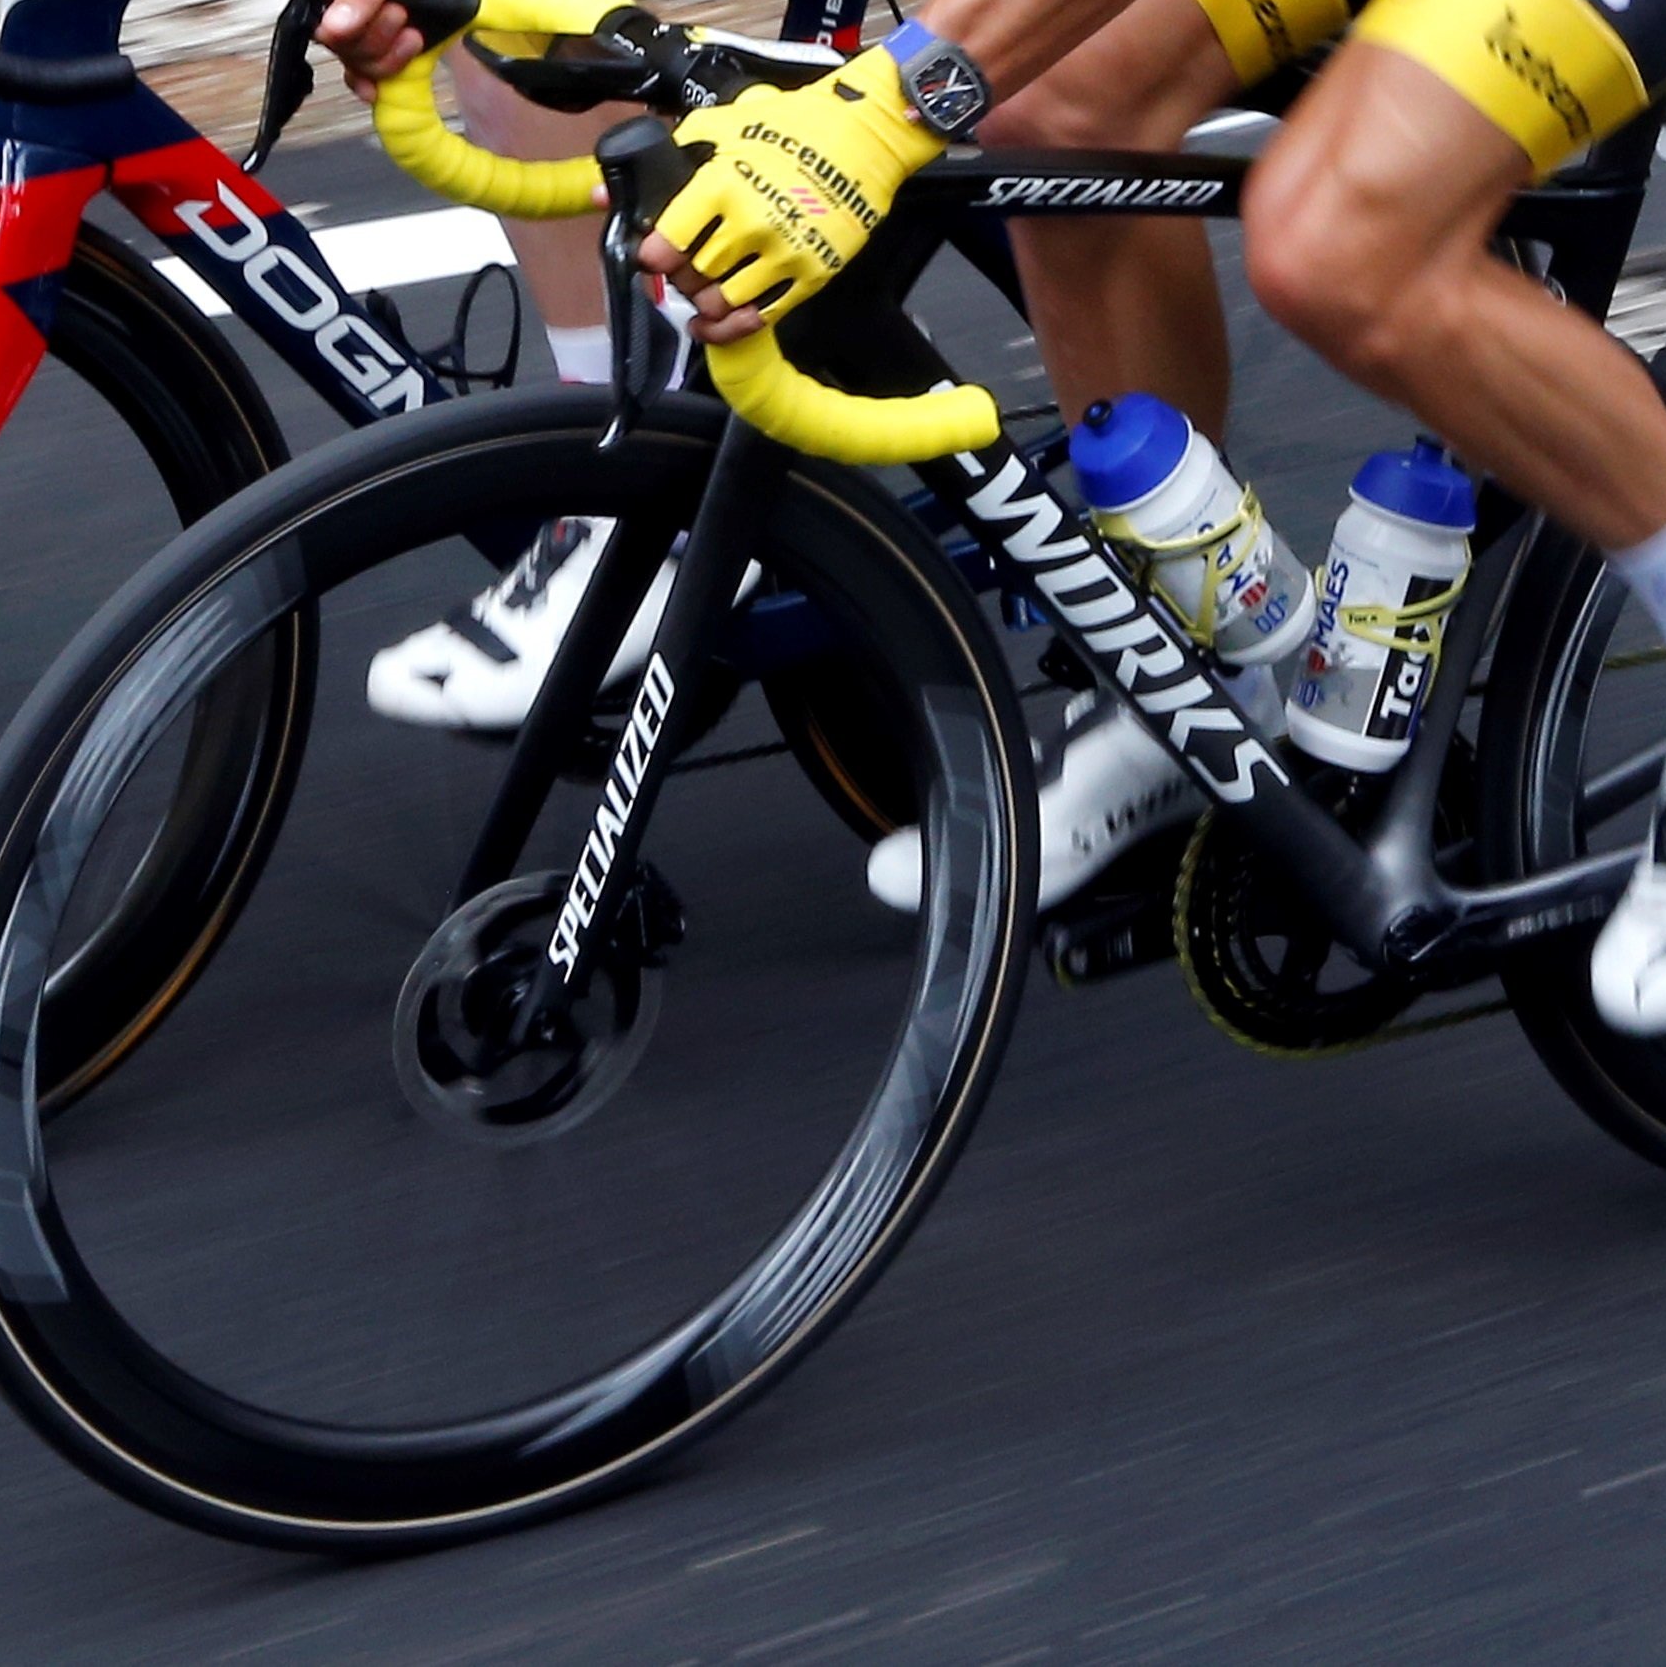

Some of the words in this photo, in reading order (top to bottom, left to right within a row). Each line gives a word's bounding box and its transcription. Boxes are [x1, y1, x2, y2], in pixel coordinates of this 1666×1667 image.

[740, 122, 880, 230] deceuninc
[970, 177, 1224, 208] SPECIALIZED
[930, 378, 1290, 804] -WORKS
[1313, 558, 1349, 649] MAES
[547, 652, 675, 984] SPECIALIZED
